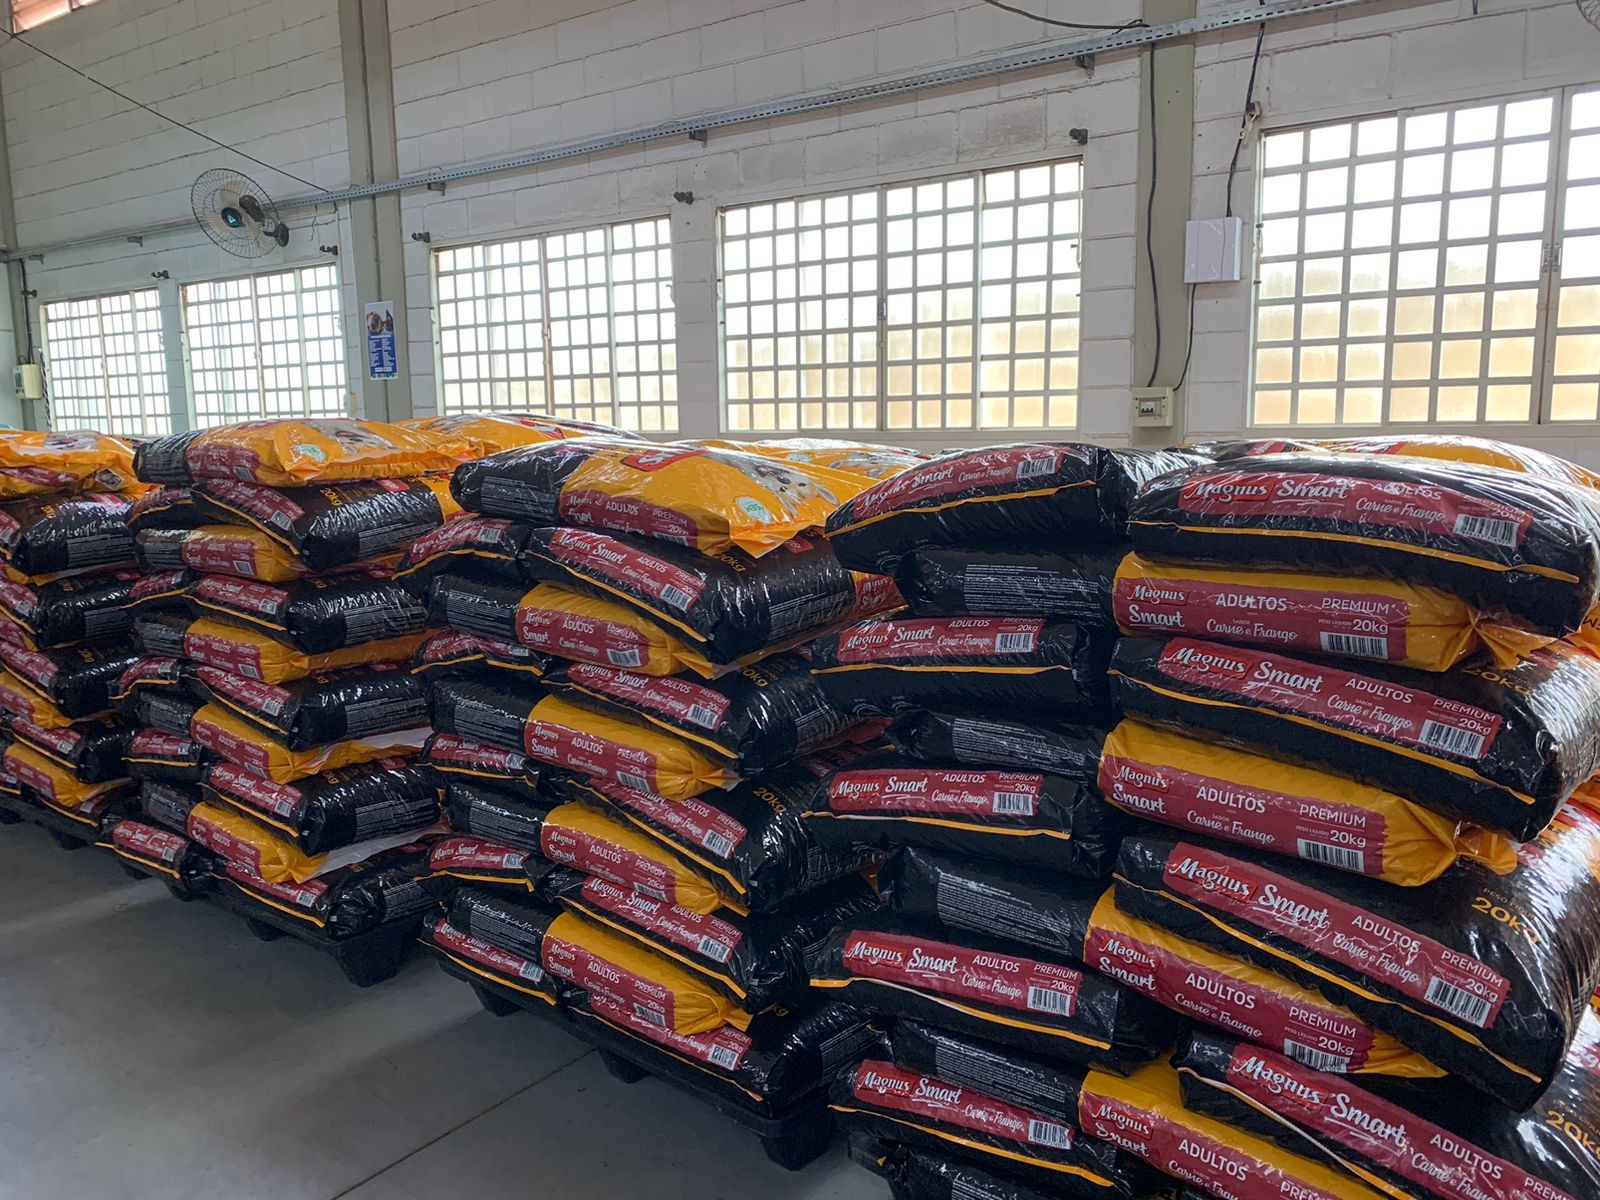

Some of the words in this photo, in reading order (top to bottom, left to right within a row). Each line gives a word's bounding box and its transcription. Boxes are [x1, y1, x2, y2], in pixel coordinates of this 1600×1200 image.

[909, 466, 954, 490] Smart
[1184, 480, 1268, 503] Magnus
[1277, 480, 1348, 499] Smart
[606, 501, 639, 515] ADULTOS
[1356, 497, 1392, 513] Carne
[1400, 503, 1446, 522] Frango
[558, 533, 591, 551] Magnus
[592, 542, 626, 564] Smart
[636, 556, 668, 572] ADULTOS
[1132, 585, 1185, 603] Magnus
[1216, 593, 1287, 611] ADULTOS
[1129, 605, 1185, 628] Smart
[1322, 597, 1390, 614] PREMIUM
[523, 627, 549, 642] Smart
[562, 619, 594, 634] ADULTOS
[949, 619, 990, 628] ADULTOS
[1017, 624, 1038, 633] 20kg
[1206, 619, 1244, 634] Carne
[1253, 624, 1298, 642] Frango
[1353, 618, 1388, 634] 20kg
[844, 632, 889, 652] Magnus
[896, 625, 935, 643] Smart
[614, 672, 649, 689] Smart
[1163, 647, 1246, 677] Magnus
[1254, 662, 1323, 694] Smart
[659, 678, 692, 694] ADULTOS
[701, 689, 729, 705] PREMIUM
[1345, 678, 1414, 704] ADULTOS
[1327, 695, 1361, 715] Carne
[1371, 707, 1412, 730] Frango
[1433, 699, 1496, 722] PREMIUM
[1458, 717, 1491, 736] 20kg
[532, 739, 559, 757] Smart
[571, 736, 604, 754] ADULTOS
[831, 781, 880, 798] Magnus
[885, 776, 928, 793] Smart
[942, 774, 986, 783] ADULTOS
[999, 772, 1039, 782] PREMIUM
[1113, 765, 1168, 788] Magnus
[1015, 783, 1036, 794] 20kg
[1113, 783, 1166, 814] Smart
[1197, 786, 1265, 814] ADULTOS
[717, 814, 744, 833] PREMIUM
[1187, 809, 1223, 831] Carne
[1232, 821, 1275, 845] Frango
[1300, 805, 1366, 827] PREMIUM
[548, 831, 576, 847] Magnus
[1330, 830, 1366, 848] 20kg
[589, 844, 622, 863] ADULTOS
[586, 878, 625, 900] Magnus
[626, 892, 661, 915] Smart
[1169, 857, 1250, 898] Magnus
[1258, 884, 1328, 929] Smart
[671, 905, 704, 923] ADULTOS
[710, 919, 740, 938] PREMIUM
[1351, 915, 1421, 953] ADULTOS
[845, 942, 903, 962] Magnus
[911, 948, 958, 974] Smart
[972, 954, 1020, 973] ADULTOS
[1099, 939, 1156, 968] Magnus
[1333, 934, 1369, 959] Carne
[1376, 951, 1420, 984] Frango
[548, 957, 575, 979] Smart
[587, 962, 620, 984] ADULTOS
[1033, 963, 1078, 980] PREMIUM
[1099, 957, 1156, 991] Smart
[1441, 951, 1503, 987] PREMIUM
[635, 980, 666, 1000] PREMIUM
[961, 974, 986, 990] Carne
[991, 982, 1022, 998] Frango
[1051, 980, 1075, 994] 20kg
[1186, 973, 1255, 1009] ADULTOS
[1464, 978, 1498, 1002] 20kg
[1174, 993, 1210, 1016] Carne
[1219, 1011, 1262, 1038] Frango
[1289, 1007, 1356, 1038] PREMIUM
[1318, 1036, 1354, 1055] 20kg
[858, 1071, 910, 1093] Magnus
[915, 1079, 963, 1104] Smart
[1234, 1056, 1322, 1104] Magnus
[1329, 1093, 1407, 1148] Smart
[993, 1114, 1023, 1131] Frango
[1091, 1104, 1150, 1135] Magnus
[1179, 1140, 1249, 1181] ADULTOS
[1430, 1134, 1503, 1179] ADULTOS
[1168, 1160, 1204, 1186] Carne
[1213, 1181, 1239, 1200] Fran
[1411, 1153, 1452, 1183] Carne
[1457, 1178, 1497, 1200] Fran
